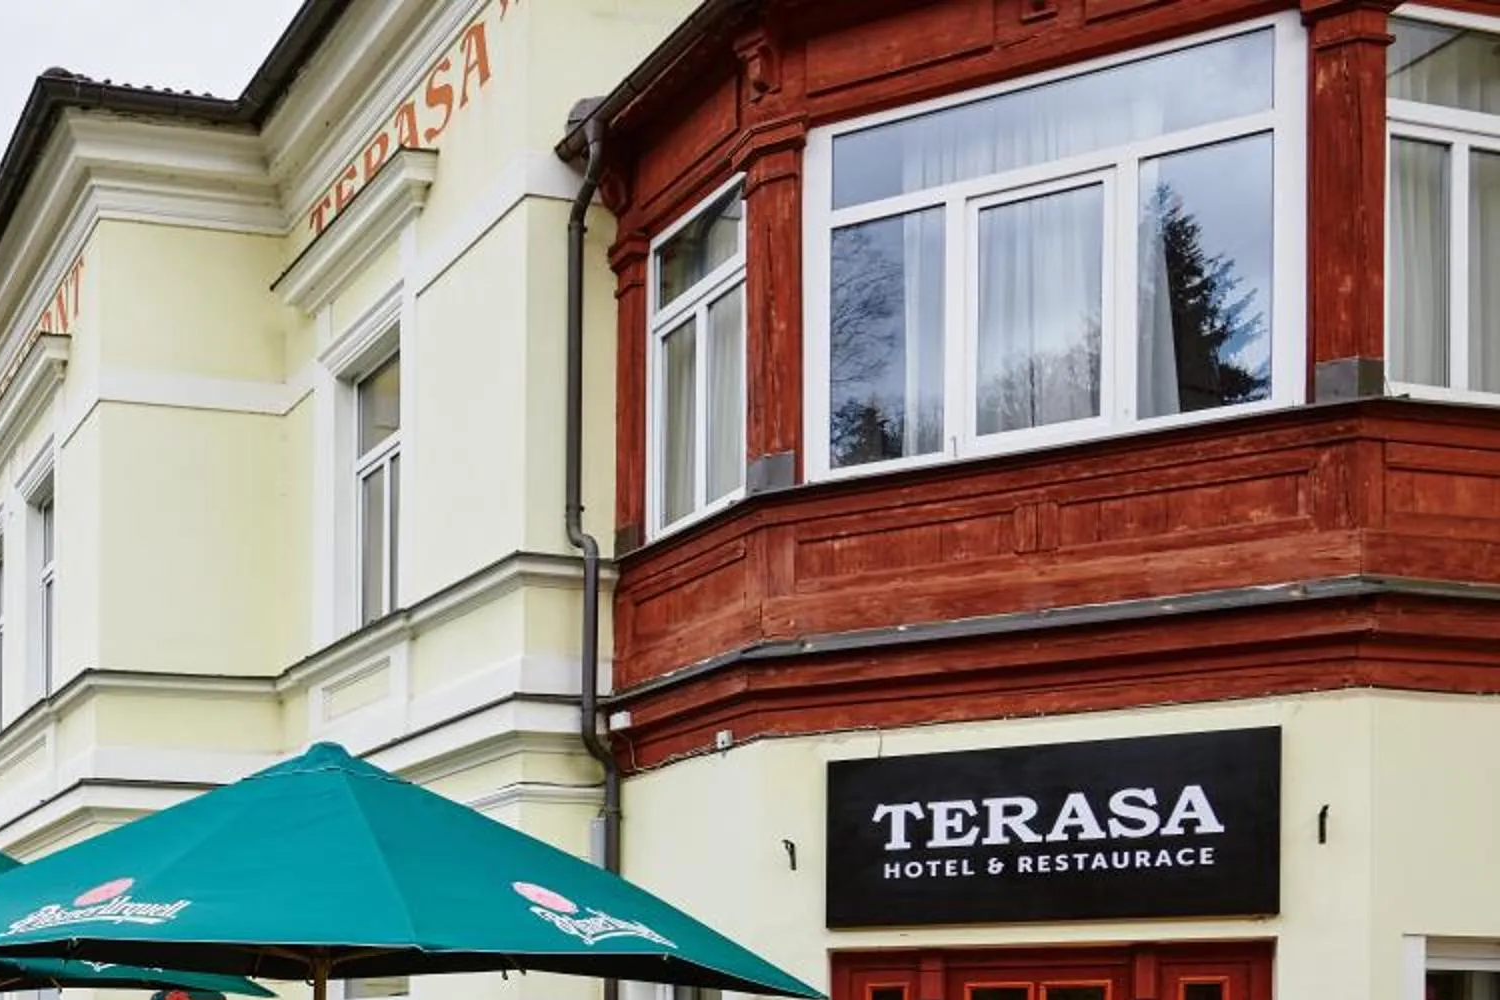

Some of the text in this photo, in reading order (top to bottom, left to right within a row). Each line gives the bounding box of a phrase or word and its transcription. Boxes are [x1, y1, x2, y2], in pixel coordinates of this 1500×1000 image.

[872, 784, 1224, 850] TERASA
[884, 847, 1215, 880] HOTEL & RESTAURACE
